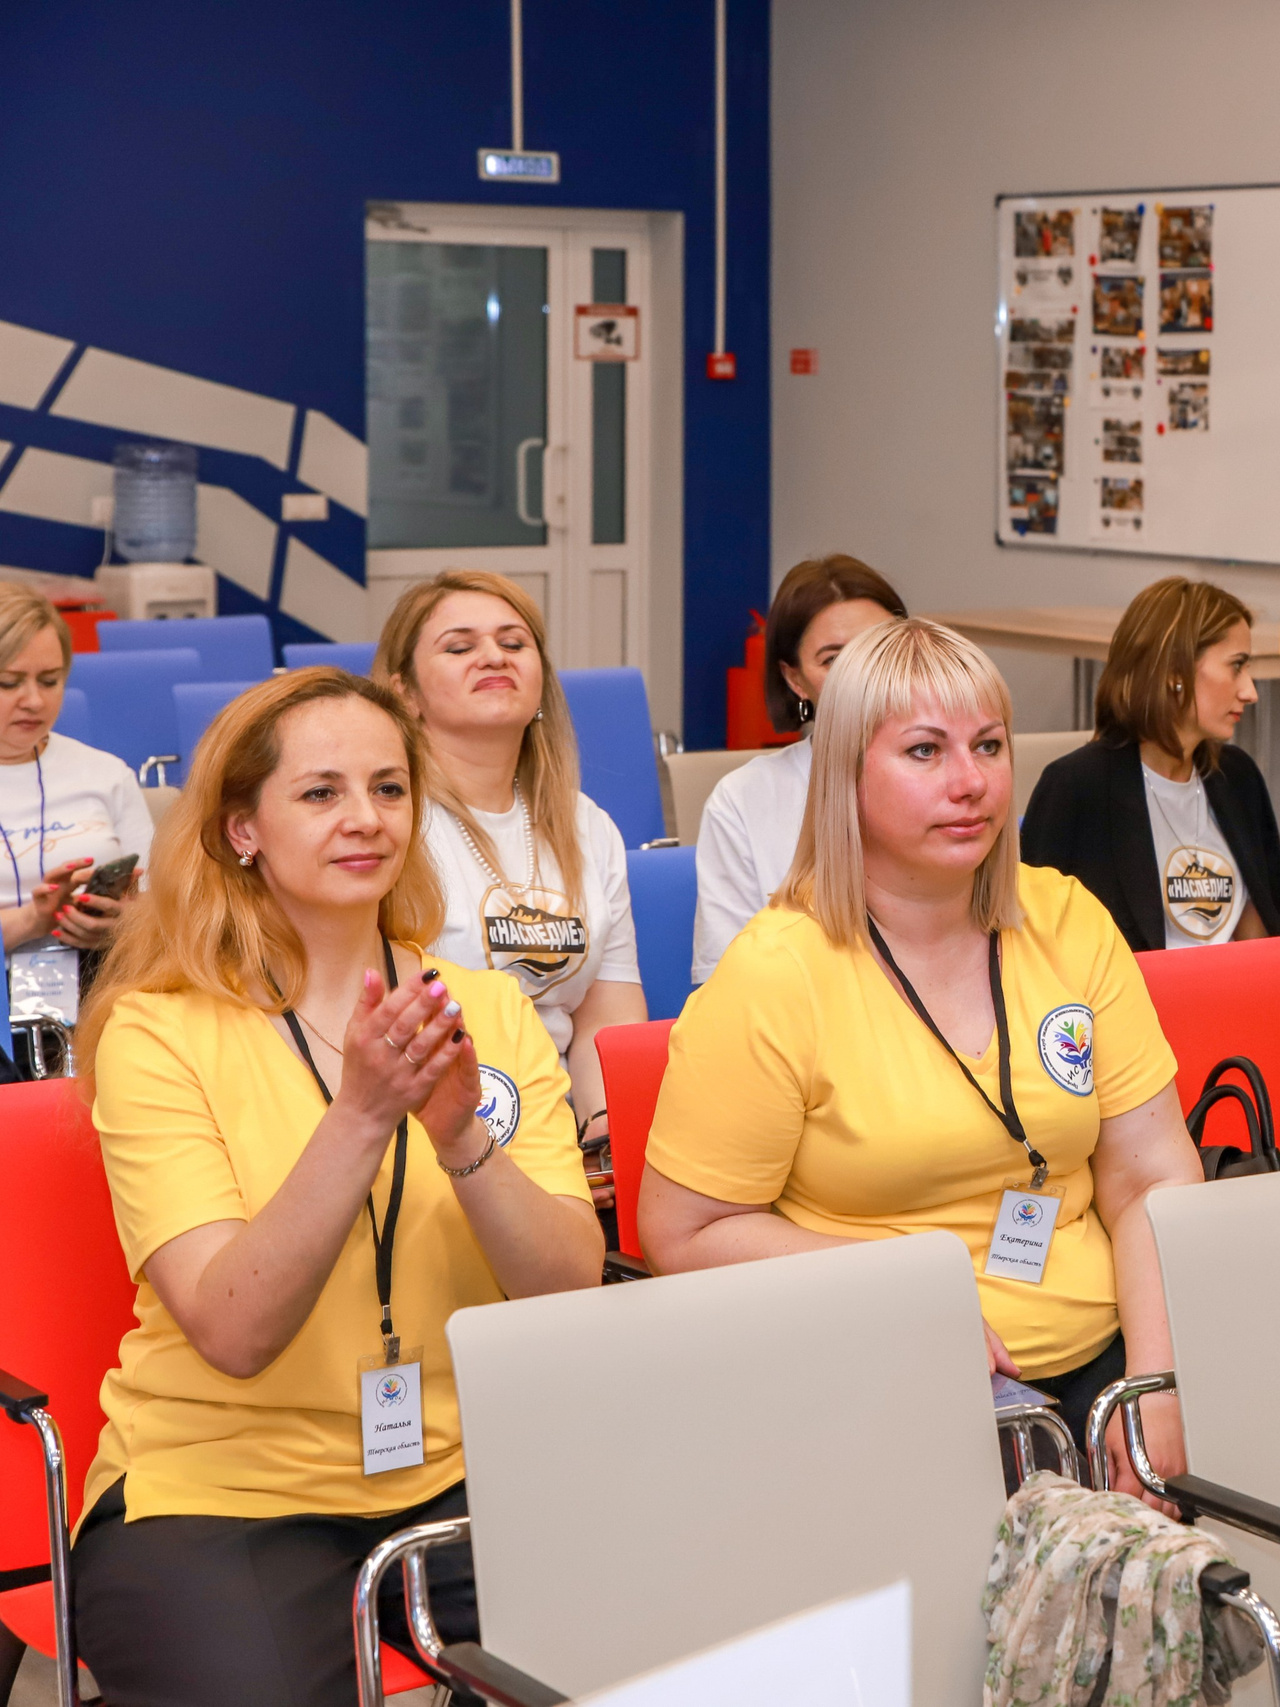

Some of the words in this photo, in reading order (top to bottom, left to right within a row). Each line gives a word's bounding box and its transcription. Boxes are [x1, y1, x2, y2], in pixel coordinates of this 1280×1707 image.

[1168, 878, 1232, 901] «НАСЛЕДИЕ»
[489, 919, 585, 951] «НАСЛЕДИЕ»
[1000, 1234, 1043, 1247] Екатерина
[991, 1253, 1018, 1263] Тверская
[1019, 1258, 1042, 1267] область
[374, 1420, 411, 1434] Наталья
[367, 1445, 396, 1456] Тверская
[397, 1442, 421, 1450] область
